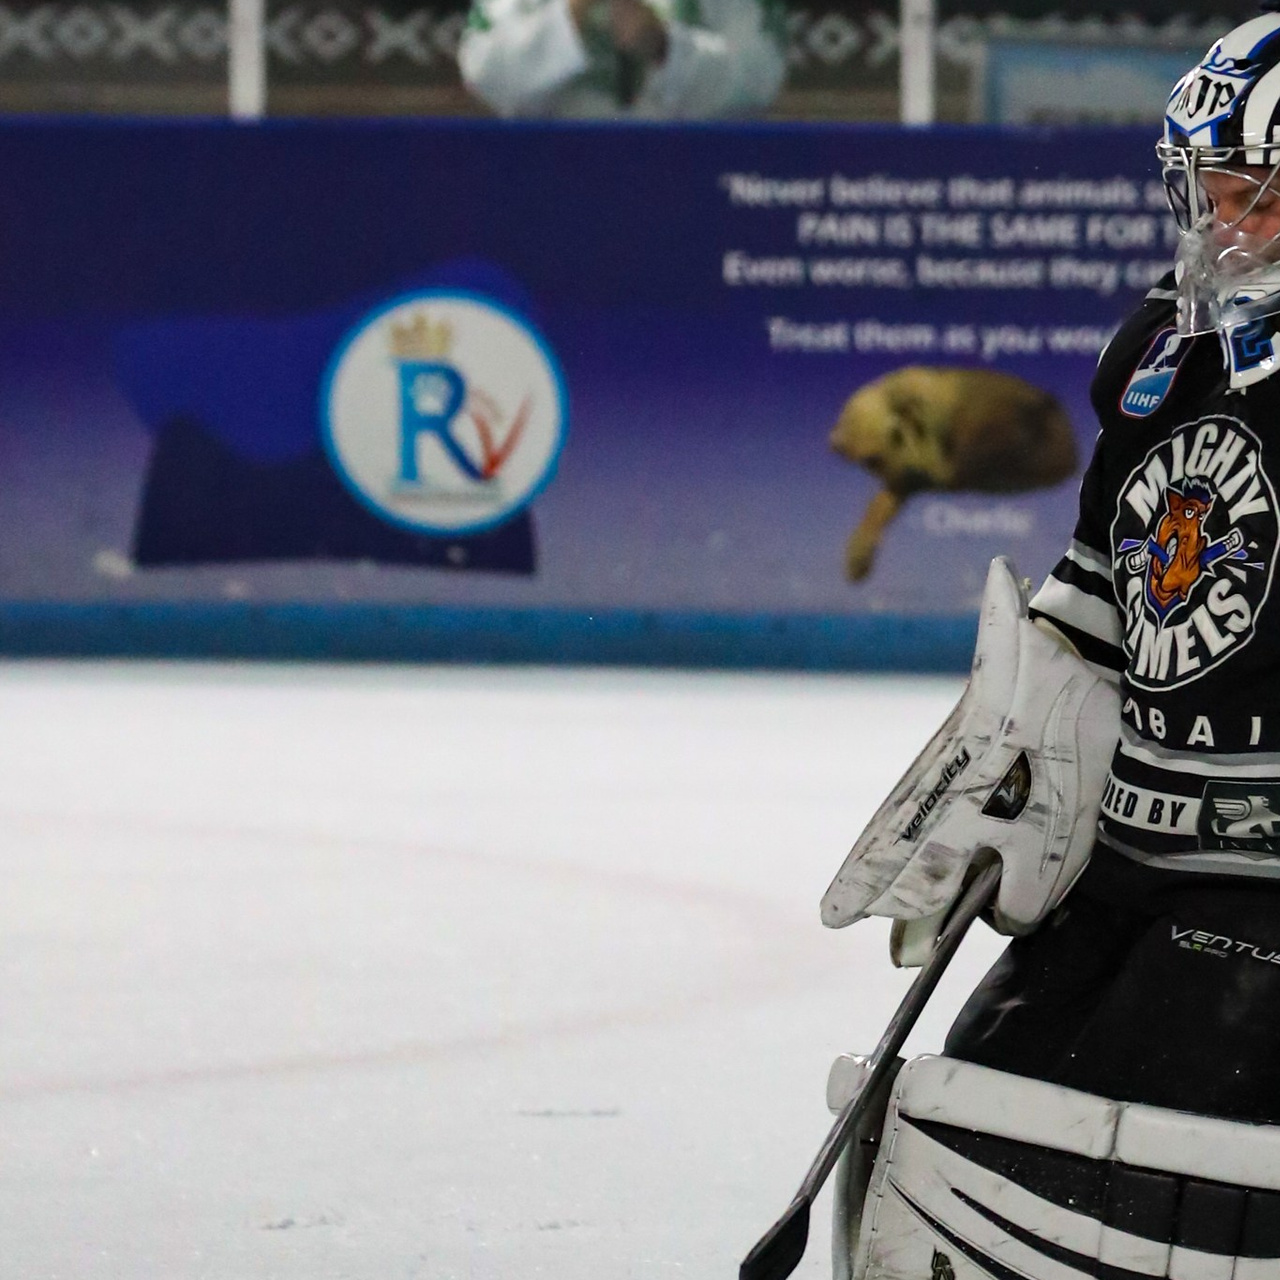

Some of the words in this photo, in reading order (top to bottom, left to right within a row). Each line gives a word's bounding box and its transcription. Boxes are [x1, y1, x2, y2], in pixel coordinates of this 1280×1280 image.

[830, 173, 941, 207] believe
[948, 175, 1014, 207] that
[1018, 175, 1137, 207] animals
[798, 211, 879, 247] PAIN
[884, 211, 912, 247] IS
[921, 211, 981, 247] THE
[990, 211, 1080, 247] SAME
[1086, 213, 1156, 247] FOR
[723, 250, 801, 287] Even
[915, 254, 1044, 288] because
[1049, 256, 1118, 295] they
[768, 317, 849, 352] Treat
[854, 319, 935, 352] them
[943, 324, 976, 352] as
[981, 324, 1043, 361] you
[1126, 390, 1160, 408] IIHF
[1125, 422, 1270, 528] MIGHTY
[893, 746, 971, 846] velocity
[1147, 797, 1187, 828] BY
